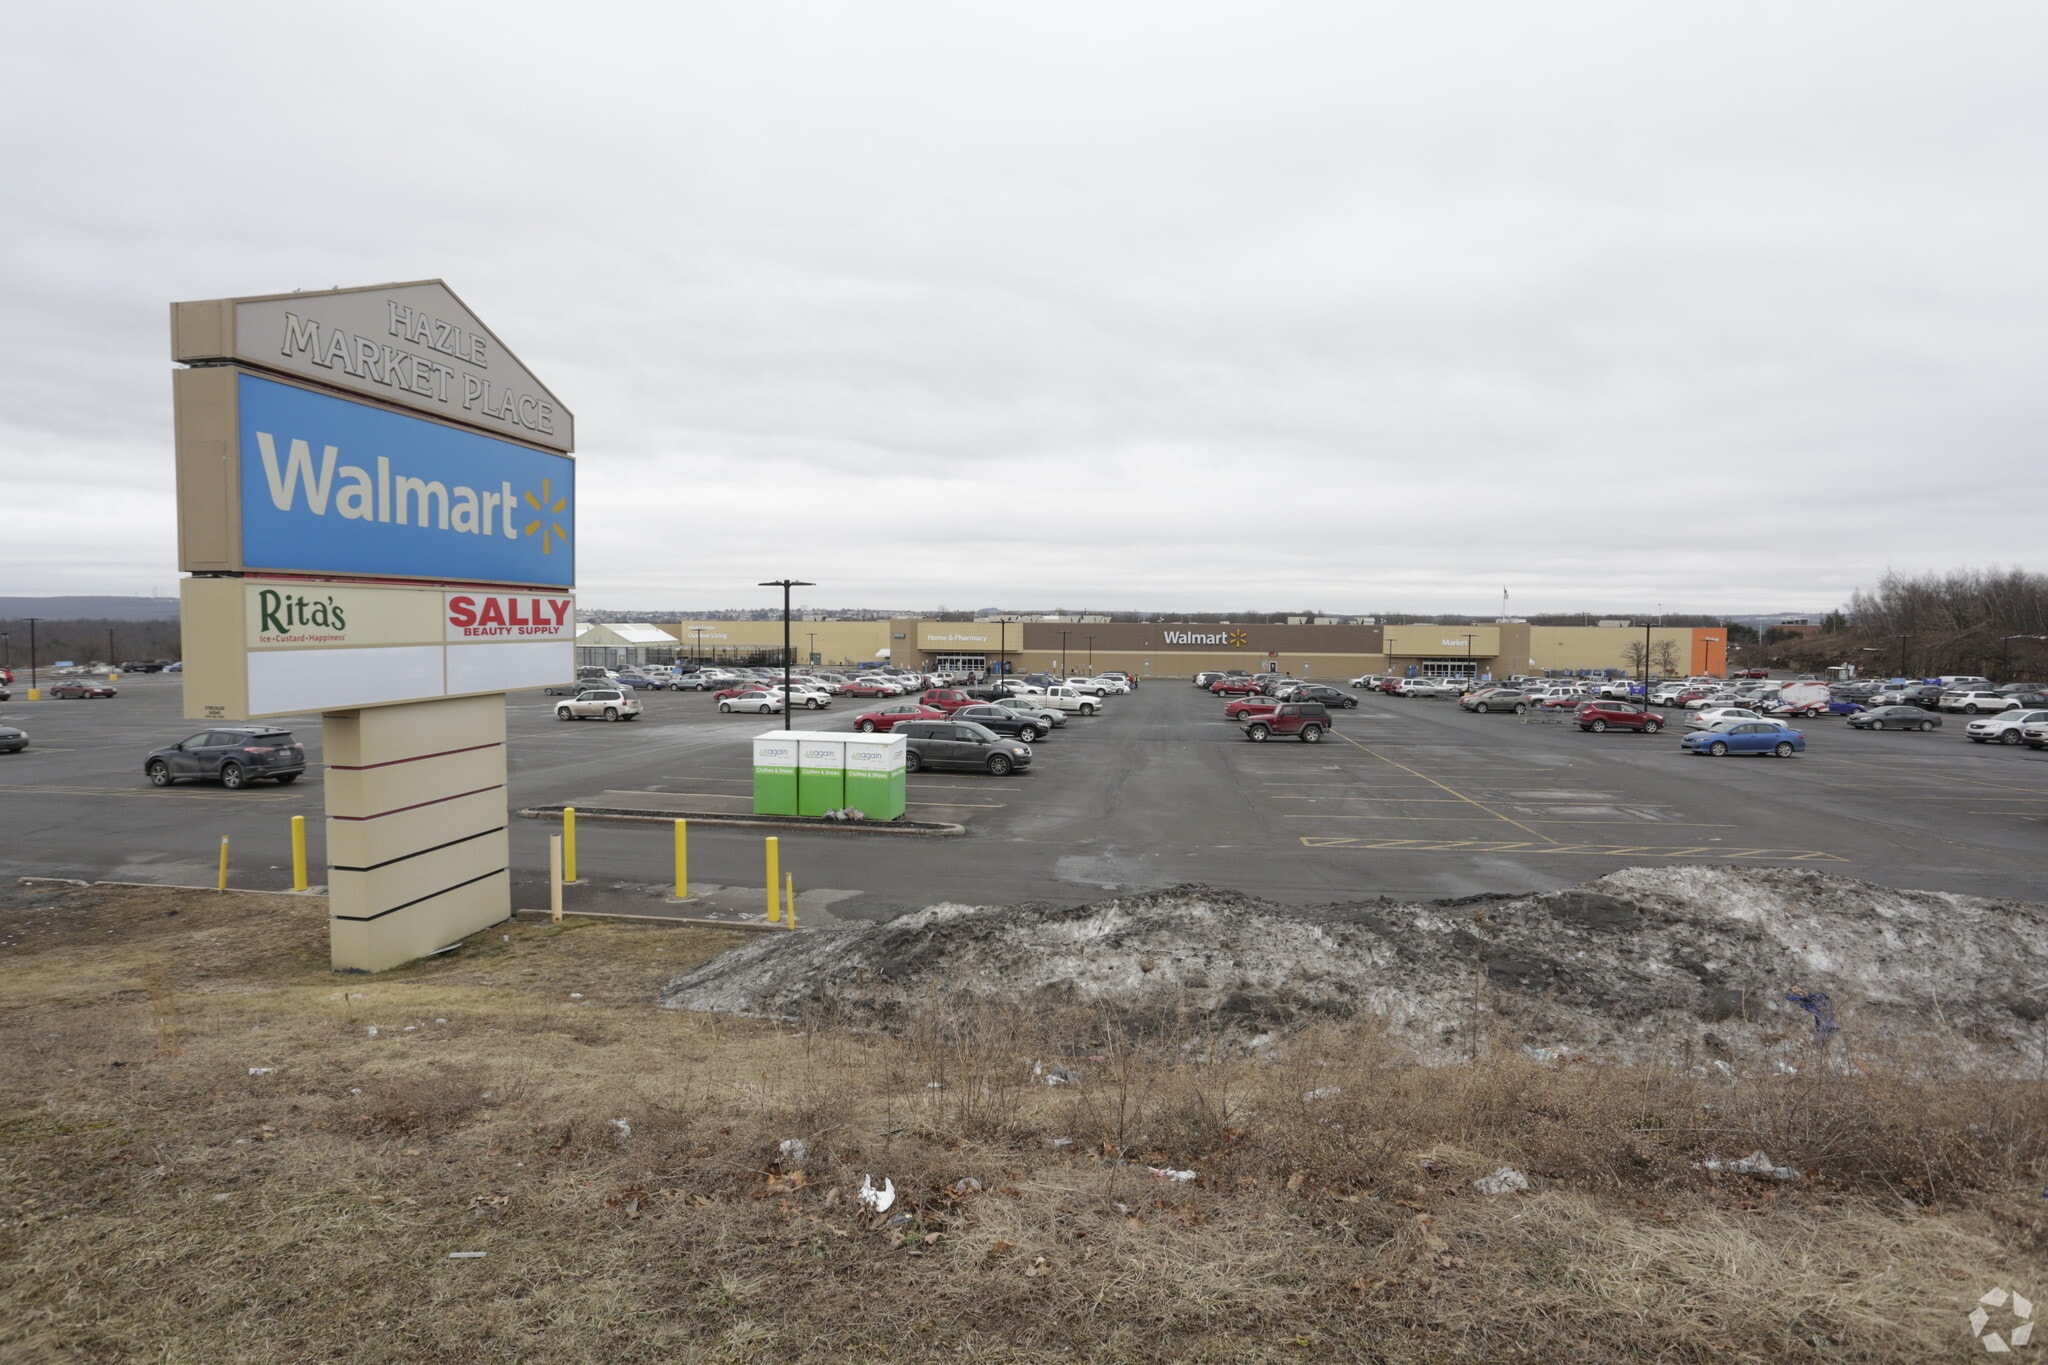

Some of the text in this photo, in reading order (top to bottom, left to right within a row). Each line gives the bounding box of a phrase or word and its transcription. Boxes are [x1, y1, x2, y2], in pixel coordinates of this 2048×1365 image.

[387, 300, 487, 369] HAZLE
[281, 311, 554, 435] MARKET PLACE
[256, 431, 518, 540] Walmart
[259, 589, 346, 634] Rita's
[449, 596, 571, 627] SALLY
[260, 633, 345, 643] Ice Custard Happiness
[464, 626, 560, 636] BEAUTY SUPPLY
[955, 634, 987, 643] Pharmacy
[1164, 631, 1228, 644] Walmart
